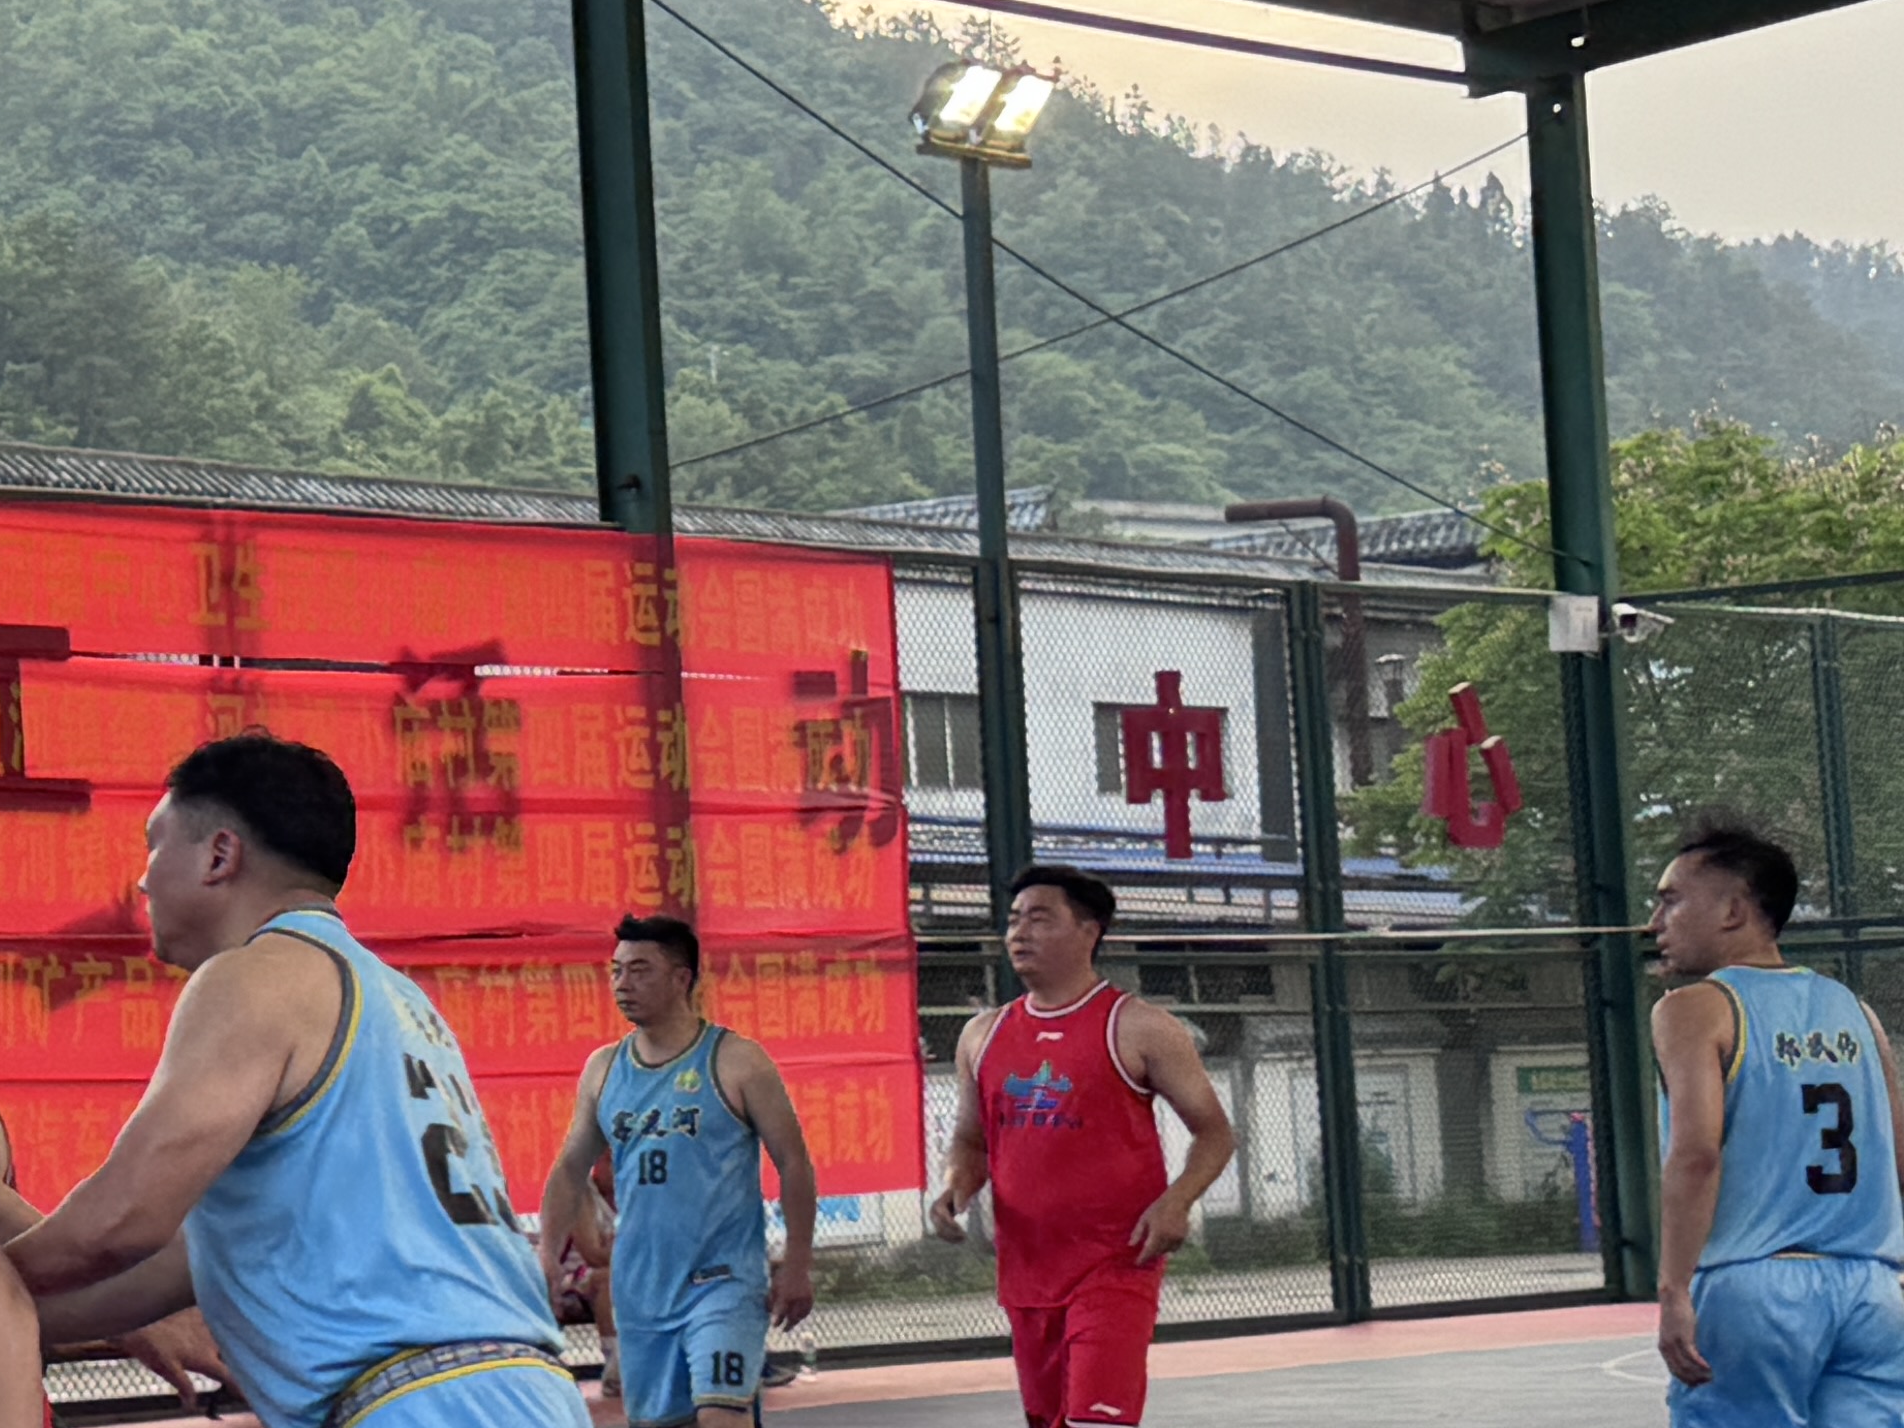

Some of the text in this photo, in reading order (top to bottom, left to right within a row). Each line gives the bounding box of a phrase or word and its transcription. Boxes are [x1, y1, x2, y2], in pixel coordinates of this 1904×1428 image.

[1120, 669, 1228, 859] 中
[1422, 681, 1522, 849] 心
[638, 1149, 667, 1185] 18
[1800, 1082, 1858, 1195] 3
[711, 1351, 744, 1386] 18
